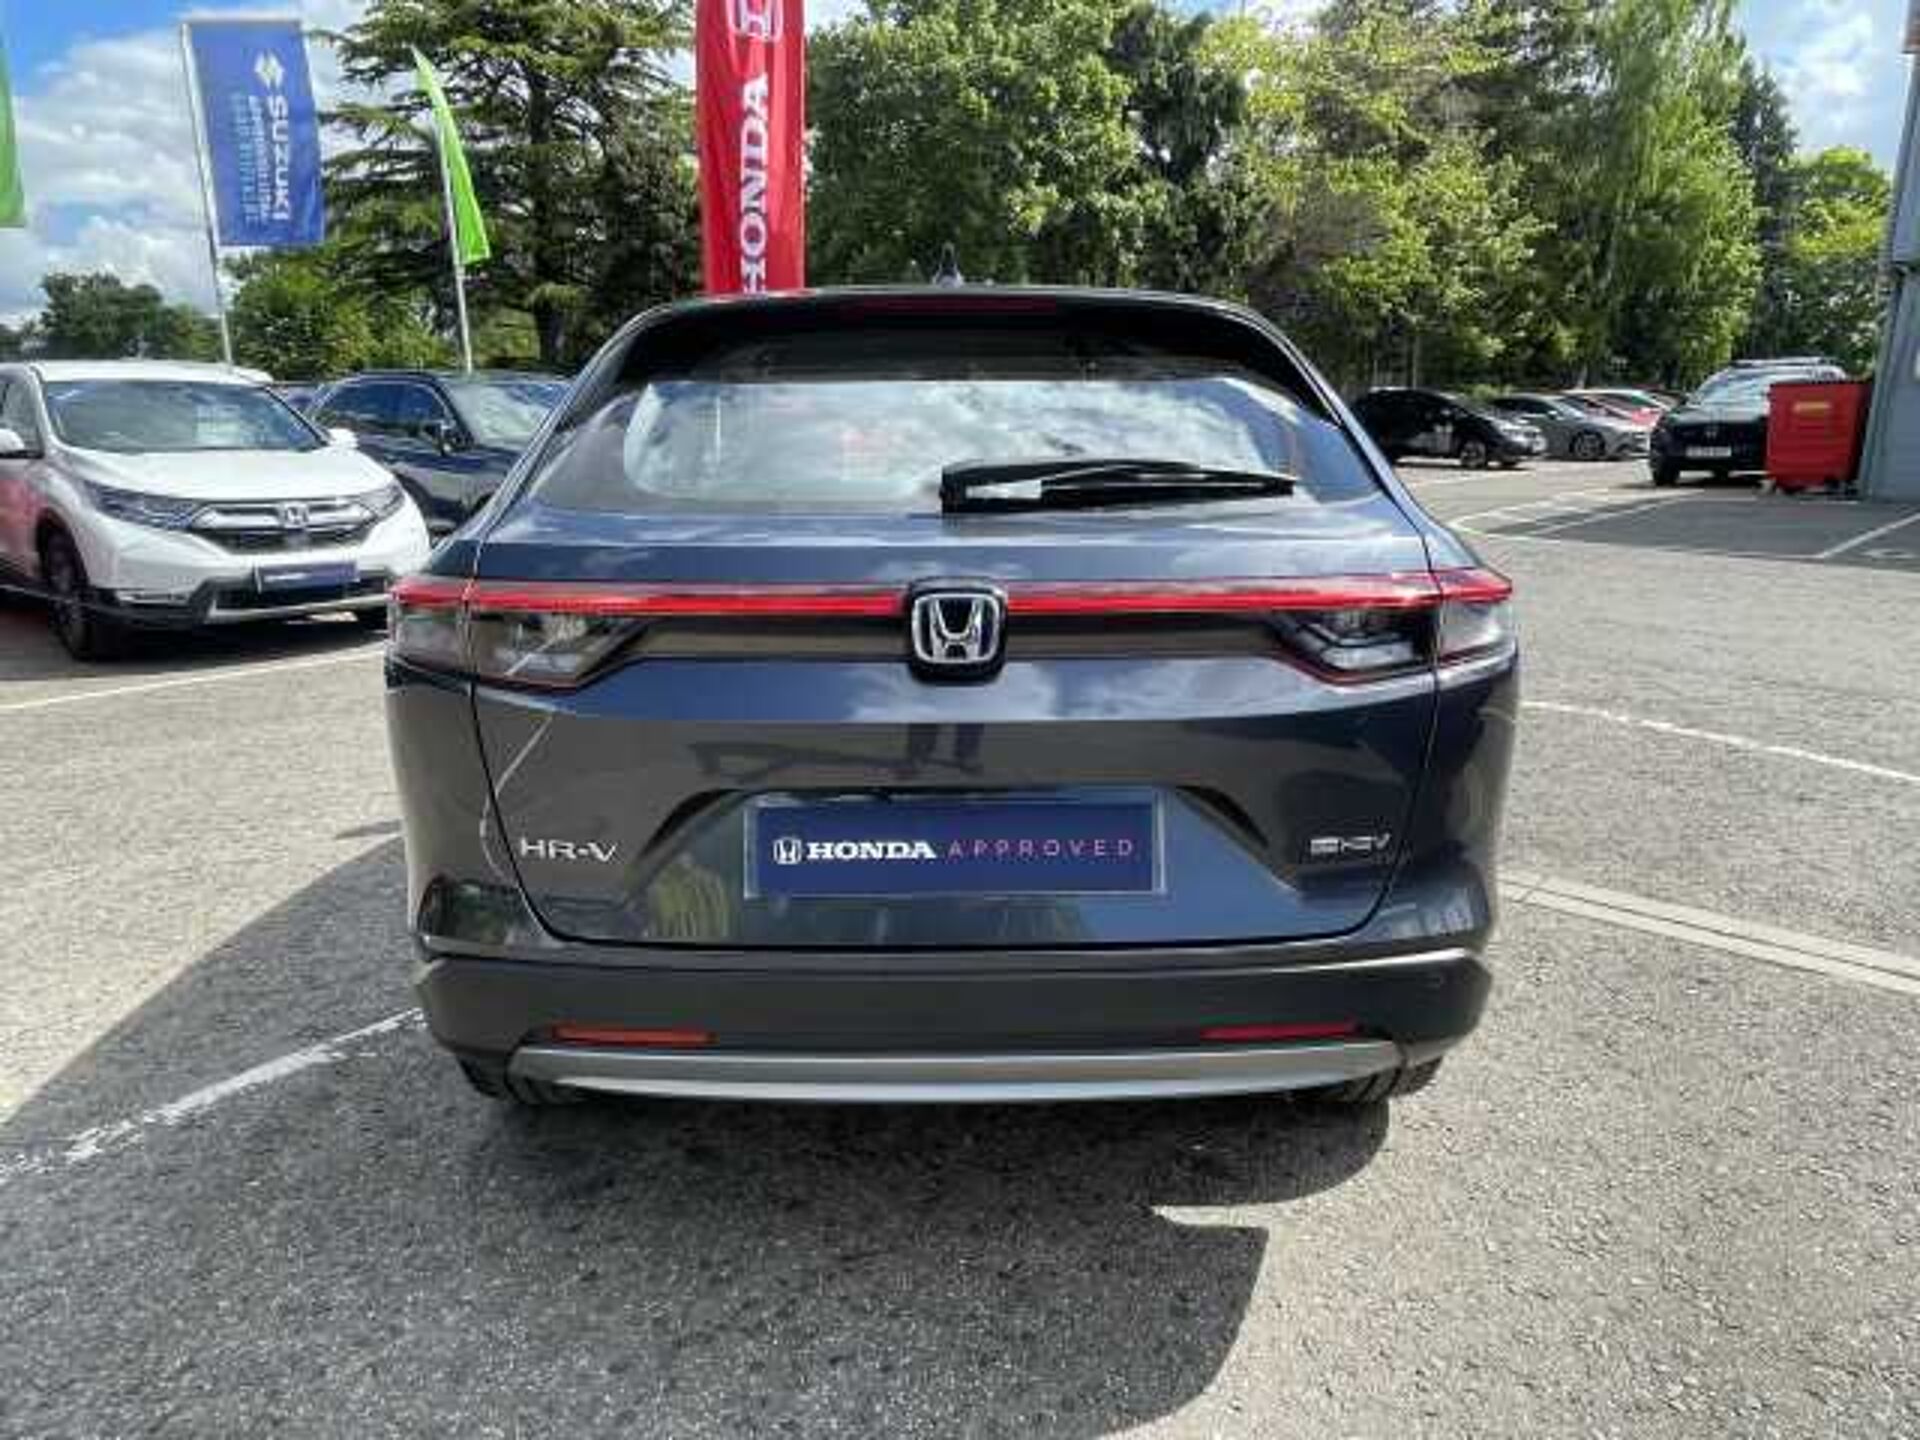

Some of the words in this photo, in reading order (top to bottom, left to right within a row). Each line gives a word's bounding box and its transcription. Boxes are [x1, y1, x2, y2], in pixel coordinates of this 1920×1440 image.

[268, 95, 290, 220] SUZUKI
[740, 74, 768, 294] HONDA
[520, 838, 618, 862] HR-V
[806, 840, 937, 860] HONDA
[948, 838, 1133, 858] APPROVED
